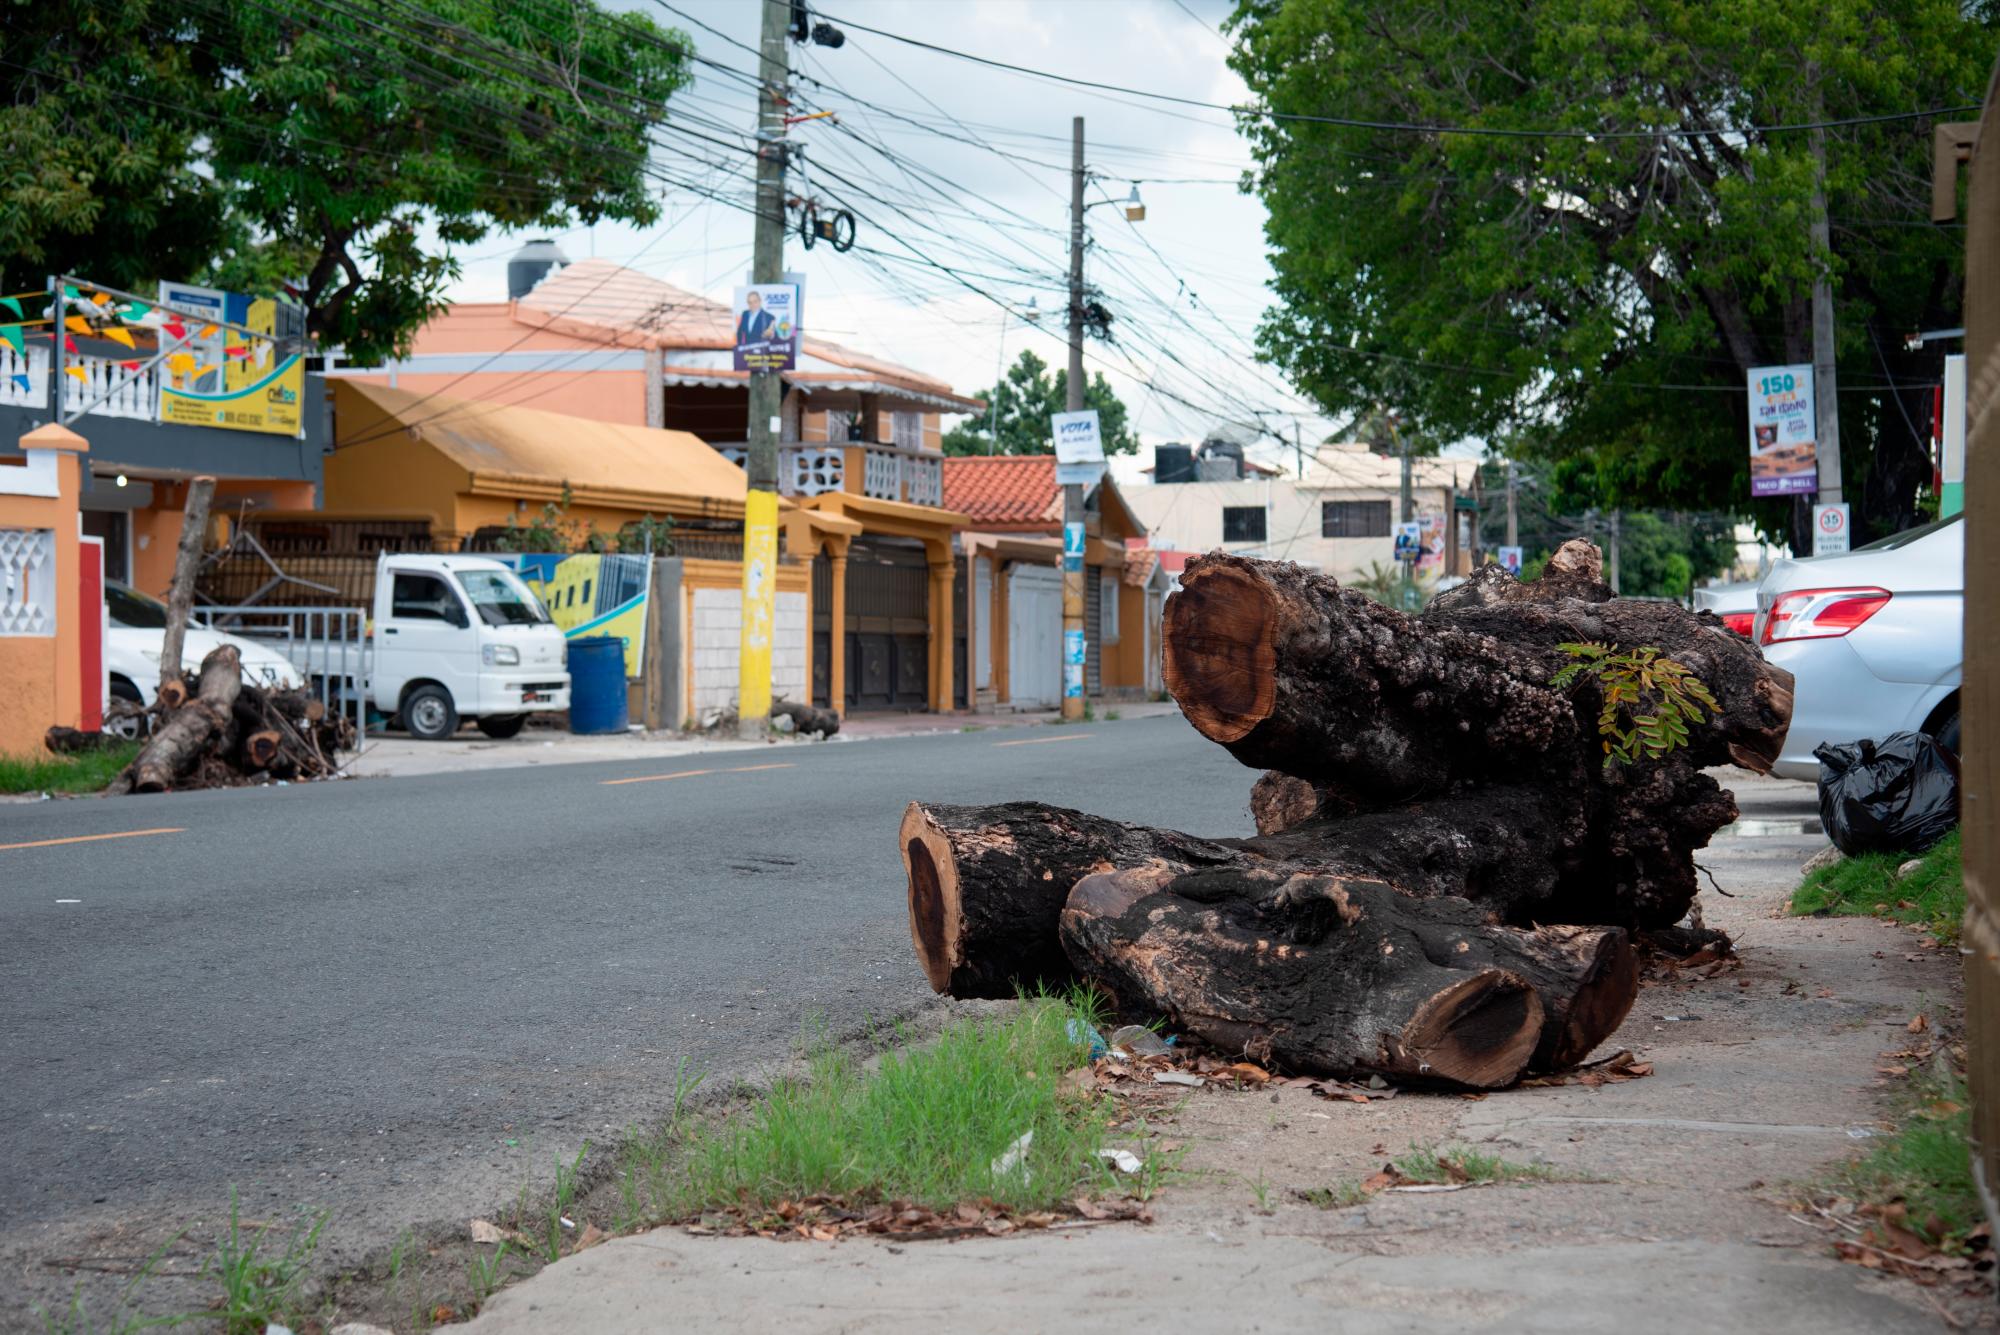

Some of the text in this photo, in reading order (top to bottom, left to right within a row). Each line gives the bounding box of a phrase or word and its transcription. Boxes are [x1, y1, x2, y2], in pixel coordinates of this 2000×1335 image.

[1060, 421, 1091, 433] VOTA
[1756, 479, 1812, 490] TACO BELL
